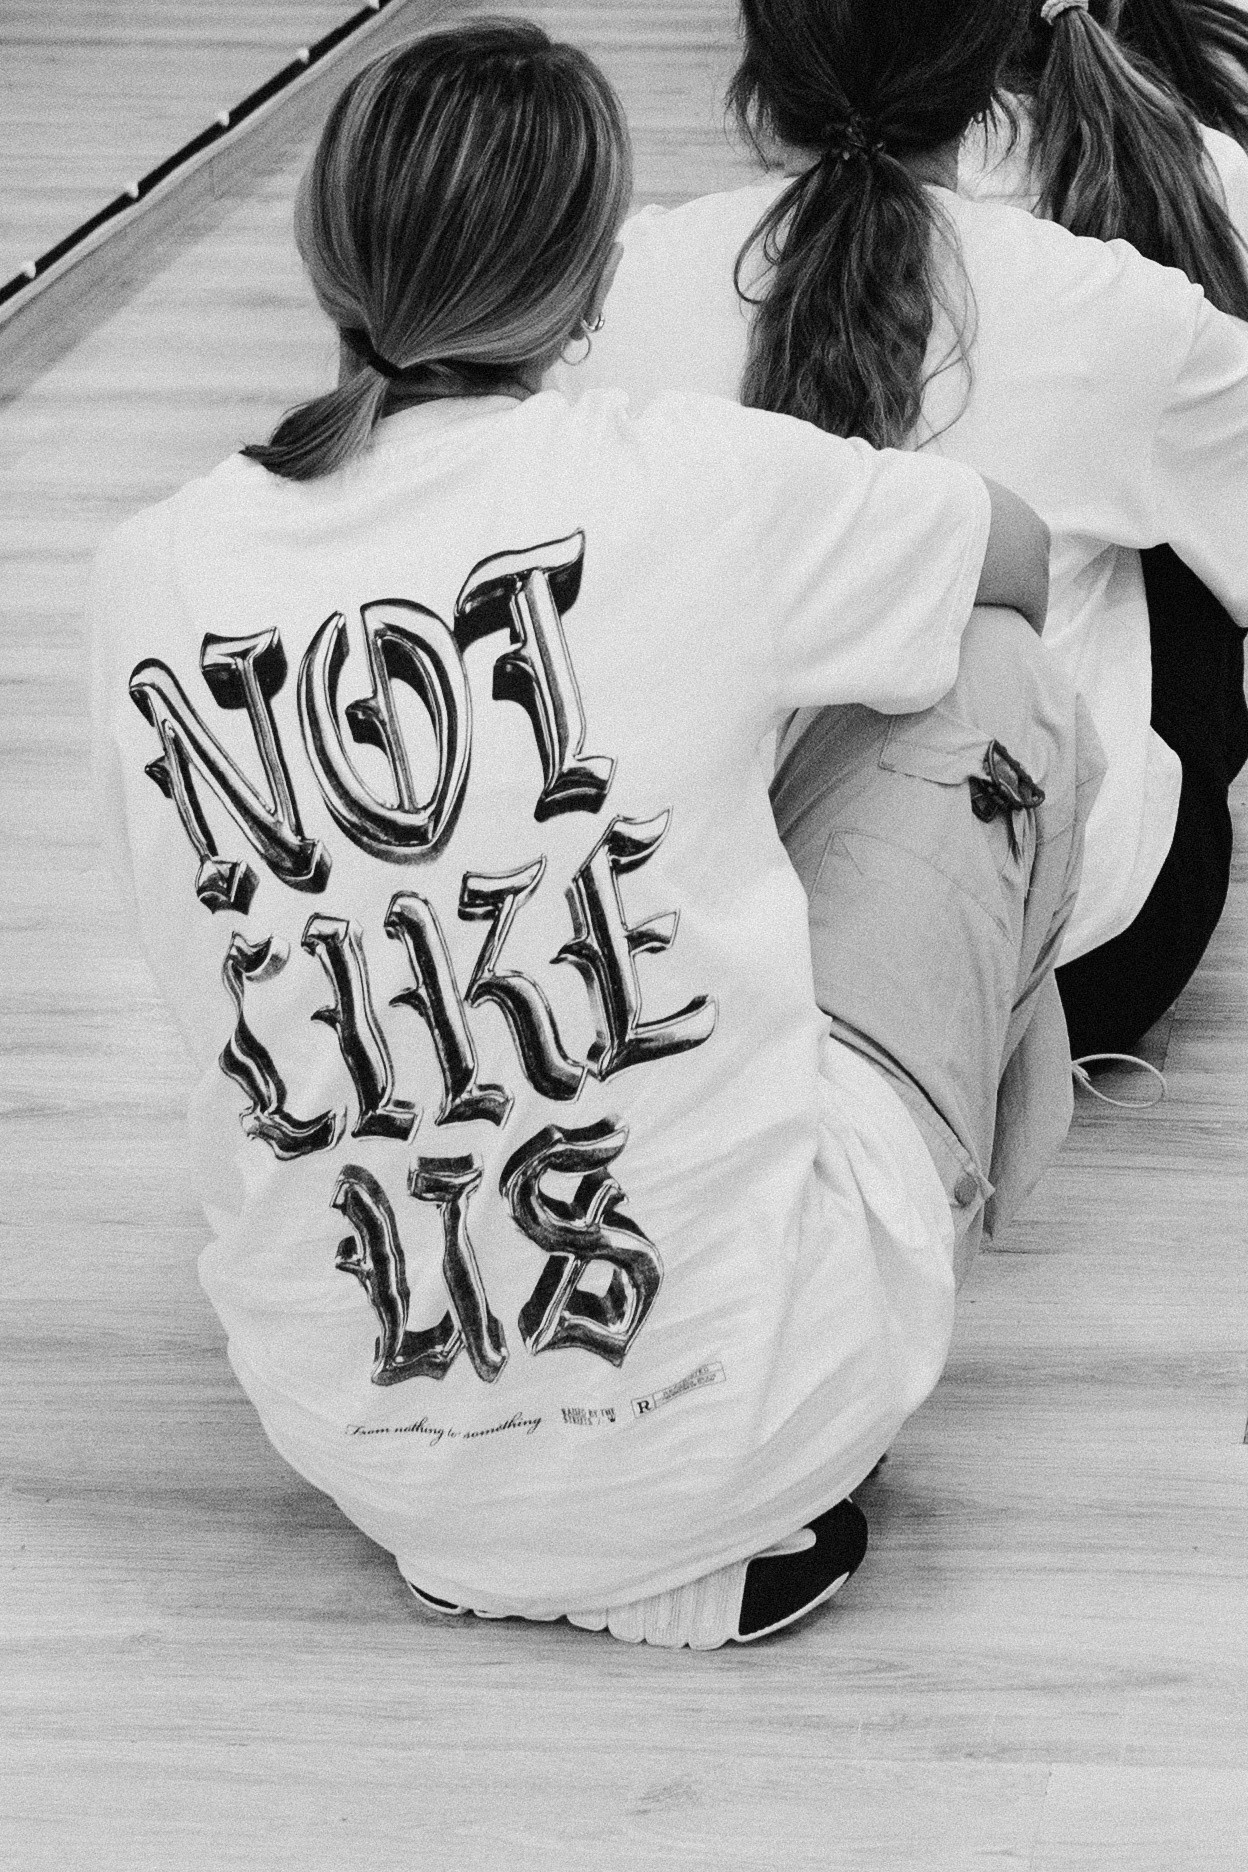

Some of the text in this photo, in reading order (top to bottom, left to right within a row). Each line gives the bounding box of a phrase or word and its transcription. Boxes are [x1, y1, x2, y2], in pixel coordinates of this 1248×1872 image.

[128, 528, 617, 915] NOT
[218, 808, 719, 1161] LIKE
[331, 1114, 665, 1385] US
[345, 1424, 390, 1436] From
[394, 1417, 445, 1446] nothing
[463, 1412, 542, 1440] something
[636, 1399, 651, 1415] R
